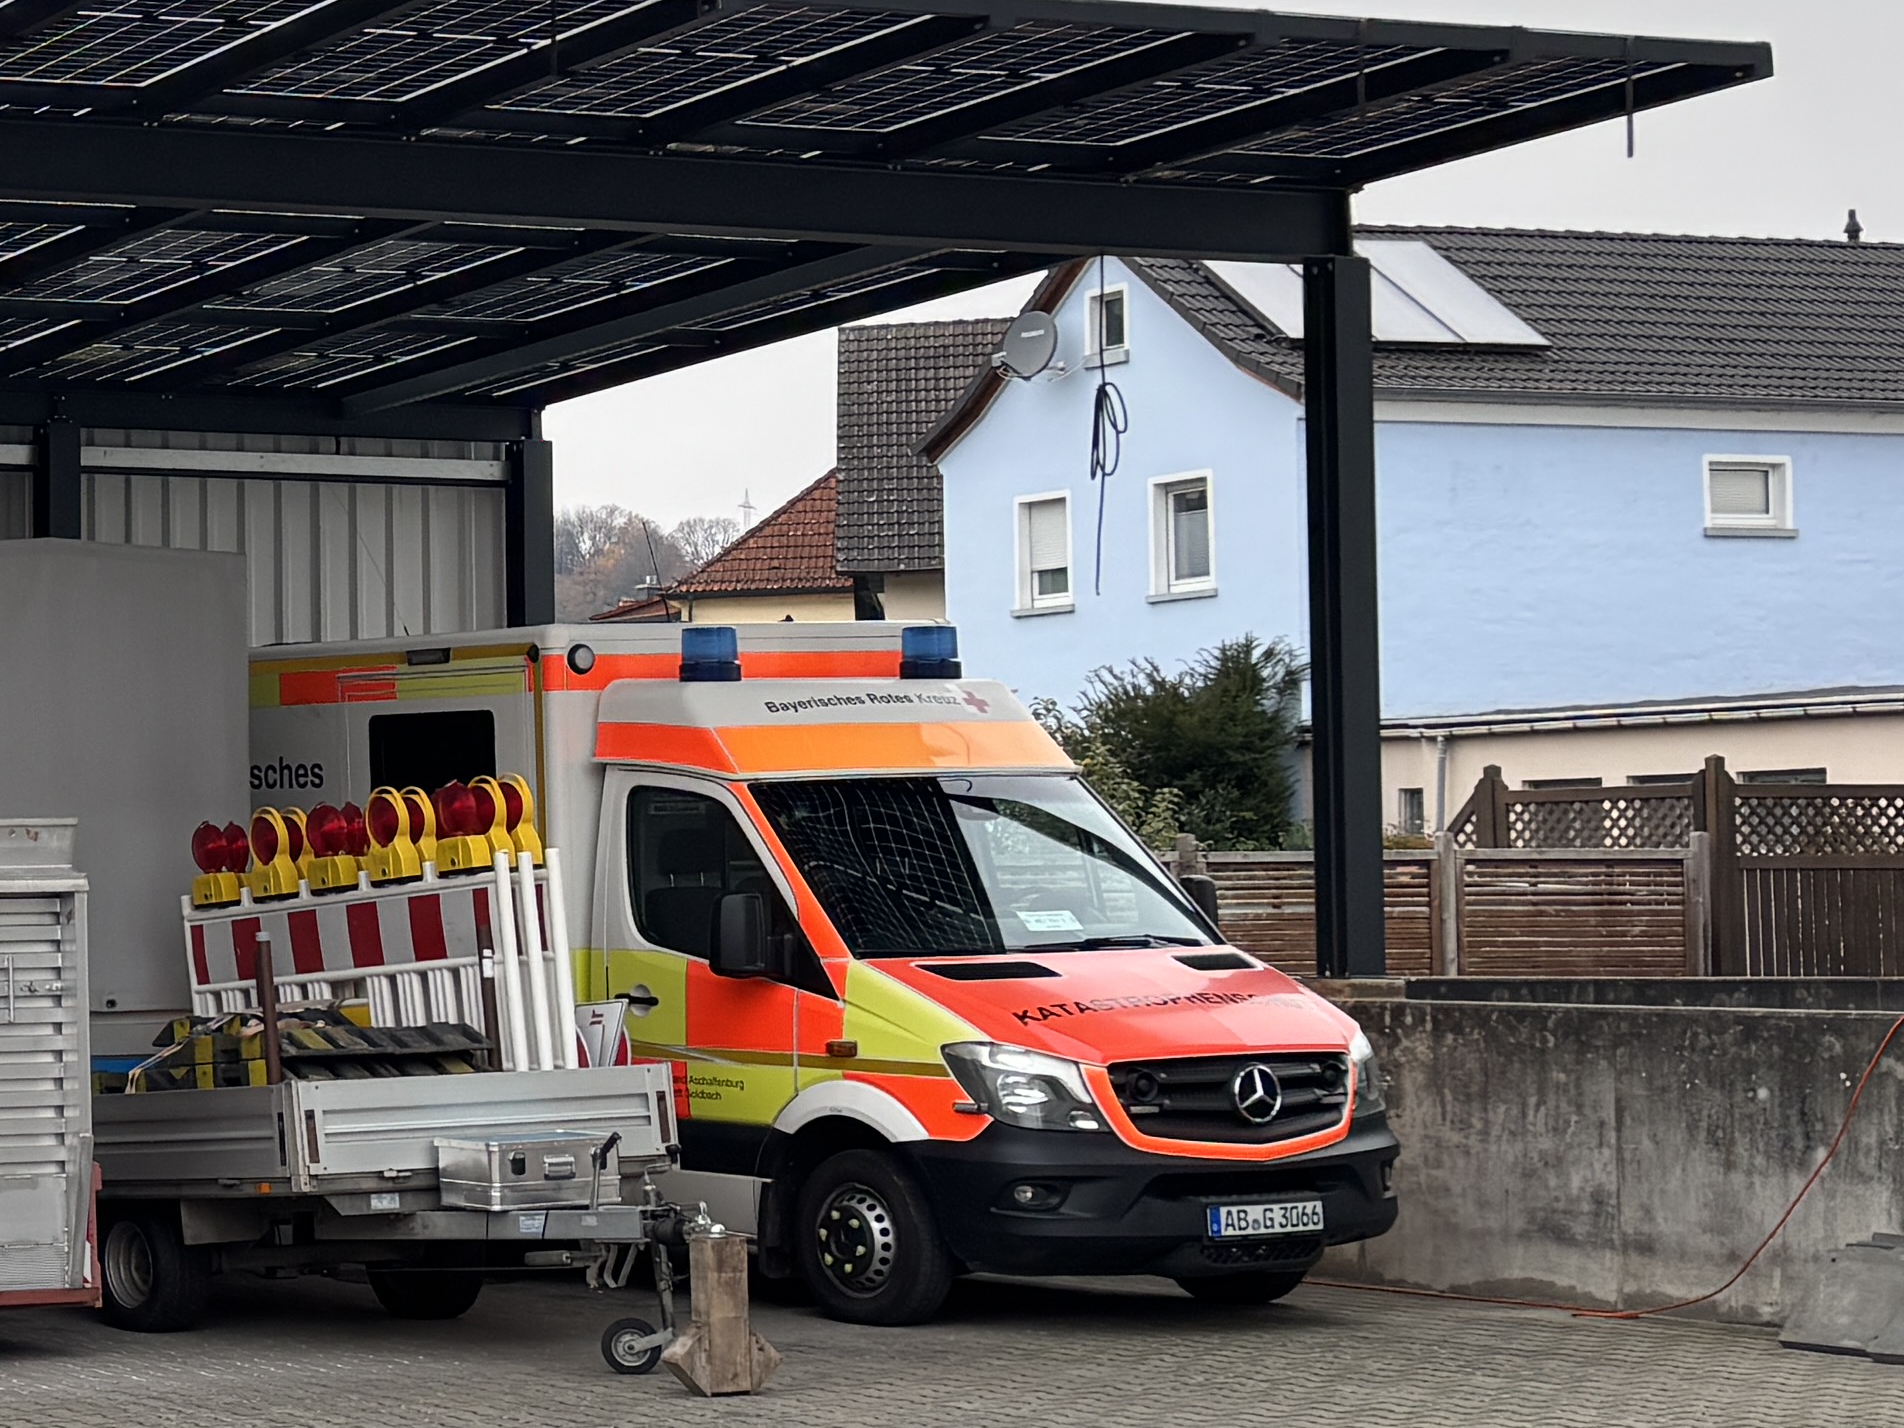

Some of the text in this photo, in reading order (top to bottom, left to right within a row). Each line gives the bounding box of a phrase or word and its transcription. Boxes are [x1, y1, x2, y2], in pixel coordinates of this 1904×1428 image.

[764, 692, 866, 714] Bayerisches
[249, 756, 324, 790] sches
[1225, 1203, 1321, 1232] AB G 3066
